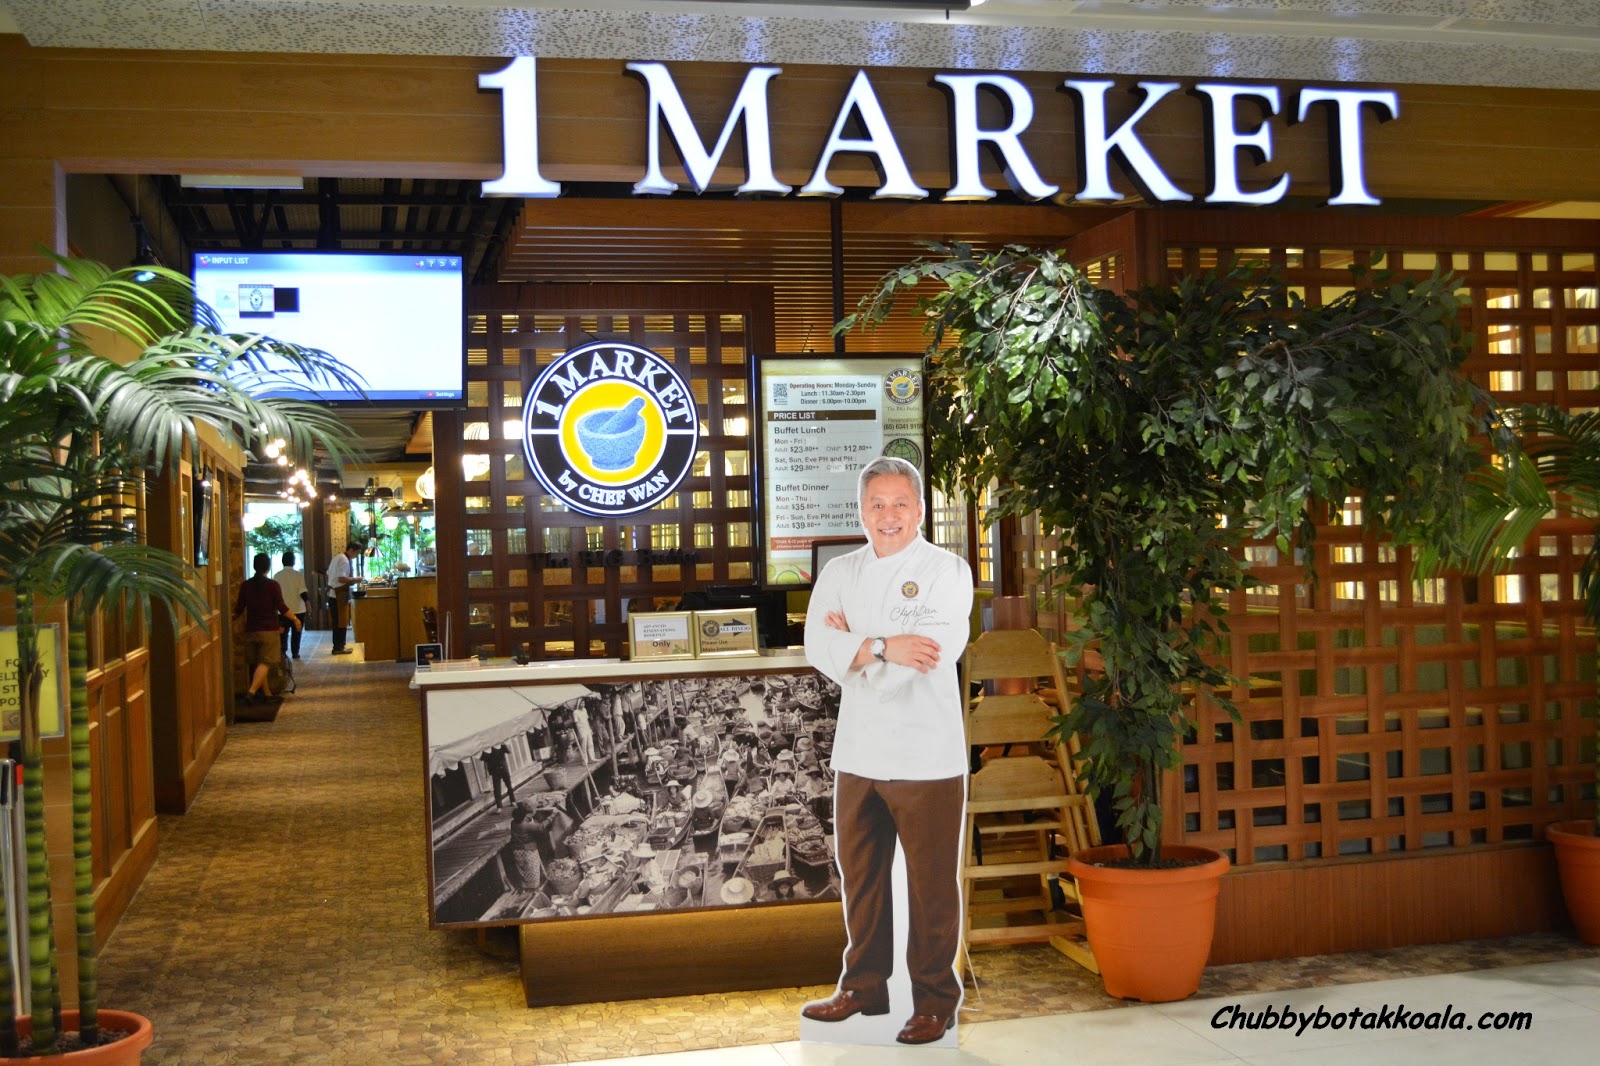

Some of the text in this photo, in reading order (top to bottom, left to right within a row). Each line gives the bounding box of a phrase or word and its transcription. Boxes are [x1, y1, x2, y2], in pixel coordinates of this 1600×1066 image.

[478, 56, 1398, 206] 1 MARKET
[535, 350, 692, 423] 1 MARKET
[773, 412, 797, 420] PRICE
[883, 423, 895, 431] (65)
[845, 463, 866, 471] $17.80
[558, 469, 670, 506] by CHEF WAN
[775, 483, 829, 492] Buffet Dinner
[652, 640, 671, 648] Only
